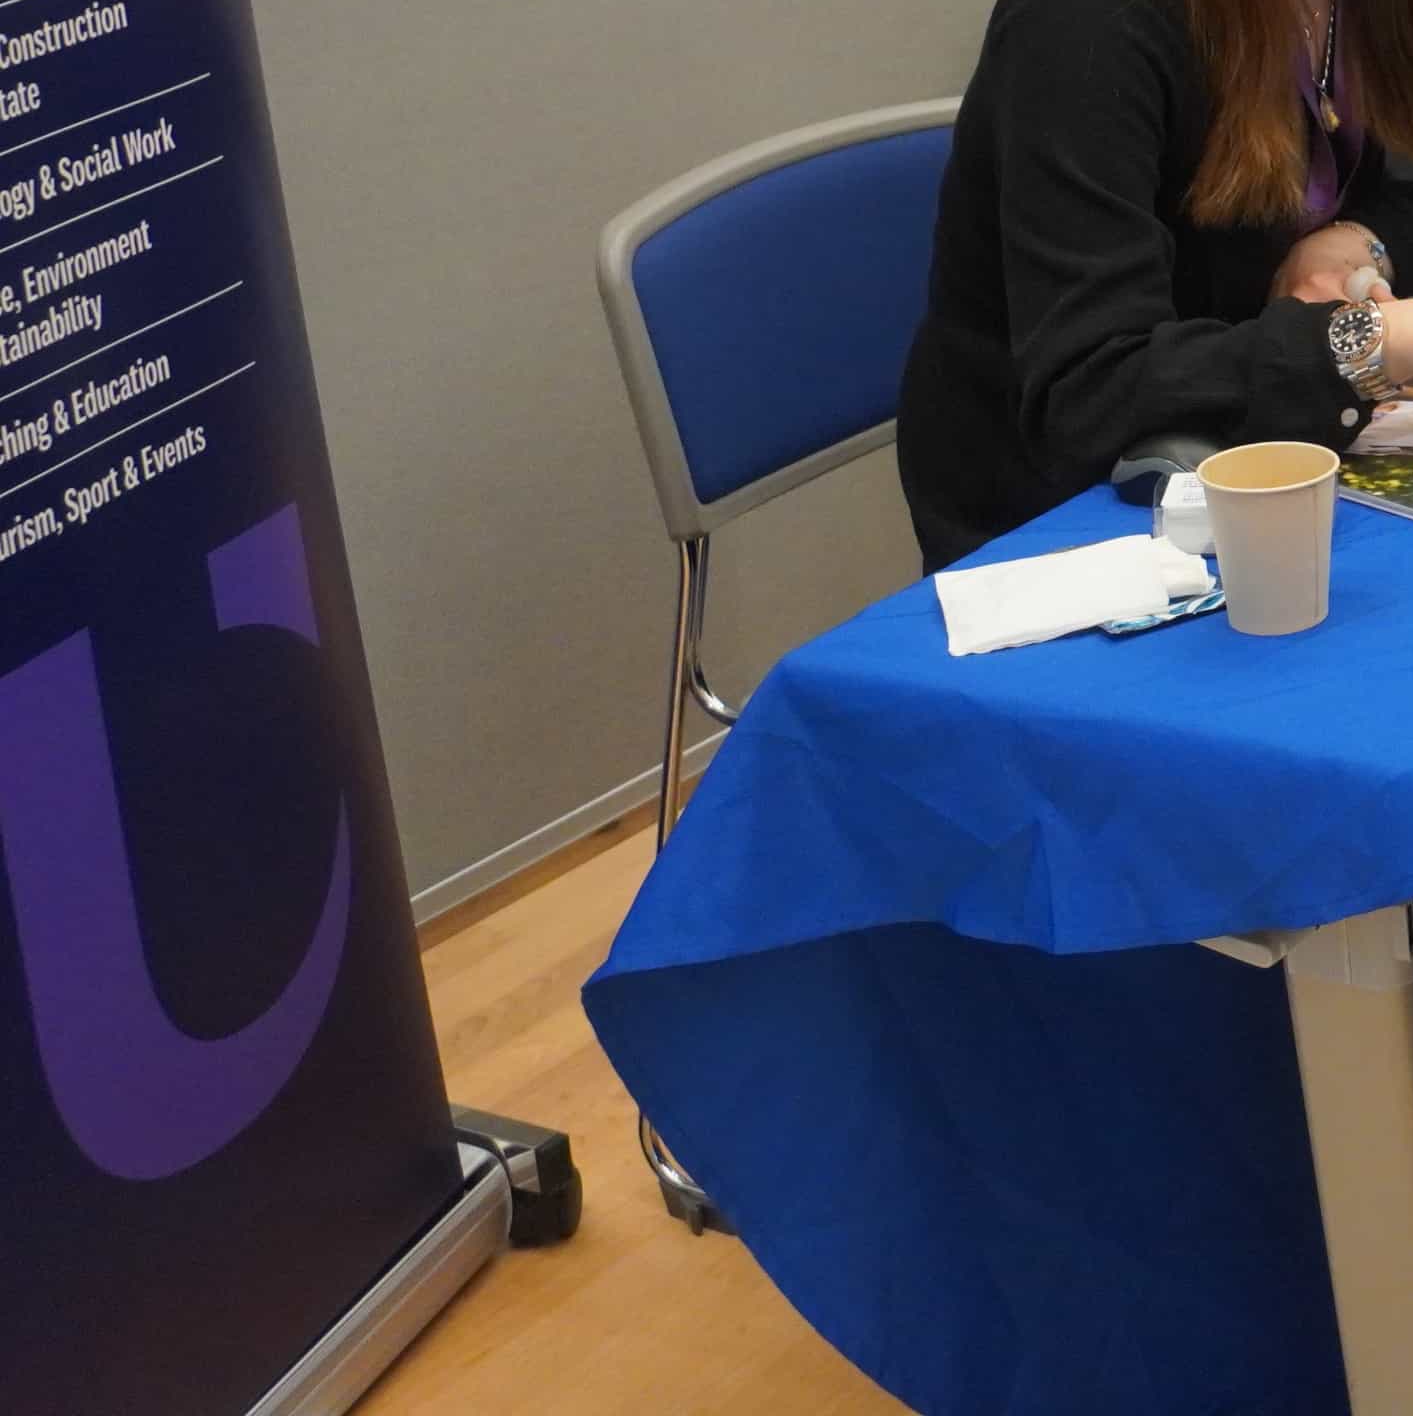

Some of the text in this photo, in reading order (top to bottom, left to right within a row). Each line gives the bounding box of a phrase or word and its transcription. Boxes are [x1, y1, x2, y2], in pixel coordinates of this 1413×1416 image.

[0, 1, 128, 70] Construction
[0, 82, 41, 122] tate
[0, 117, 176, 221] ogy & Social Work
[22, 220, 152, 304] Environment
[0, 293, 103, 369] tainability
[53, 400, 71, 435] &
[71, 354, 171, 425] Education
[0, 426, 207, 562] urism, Sport & Events
